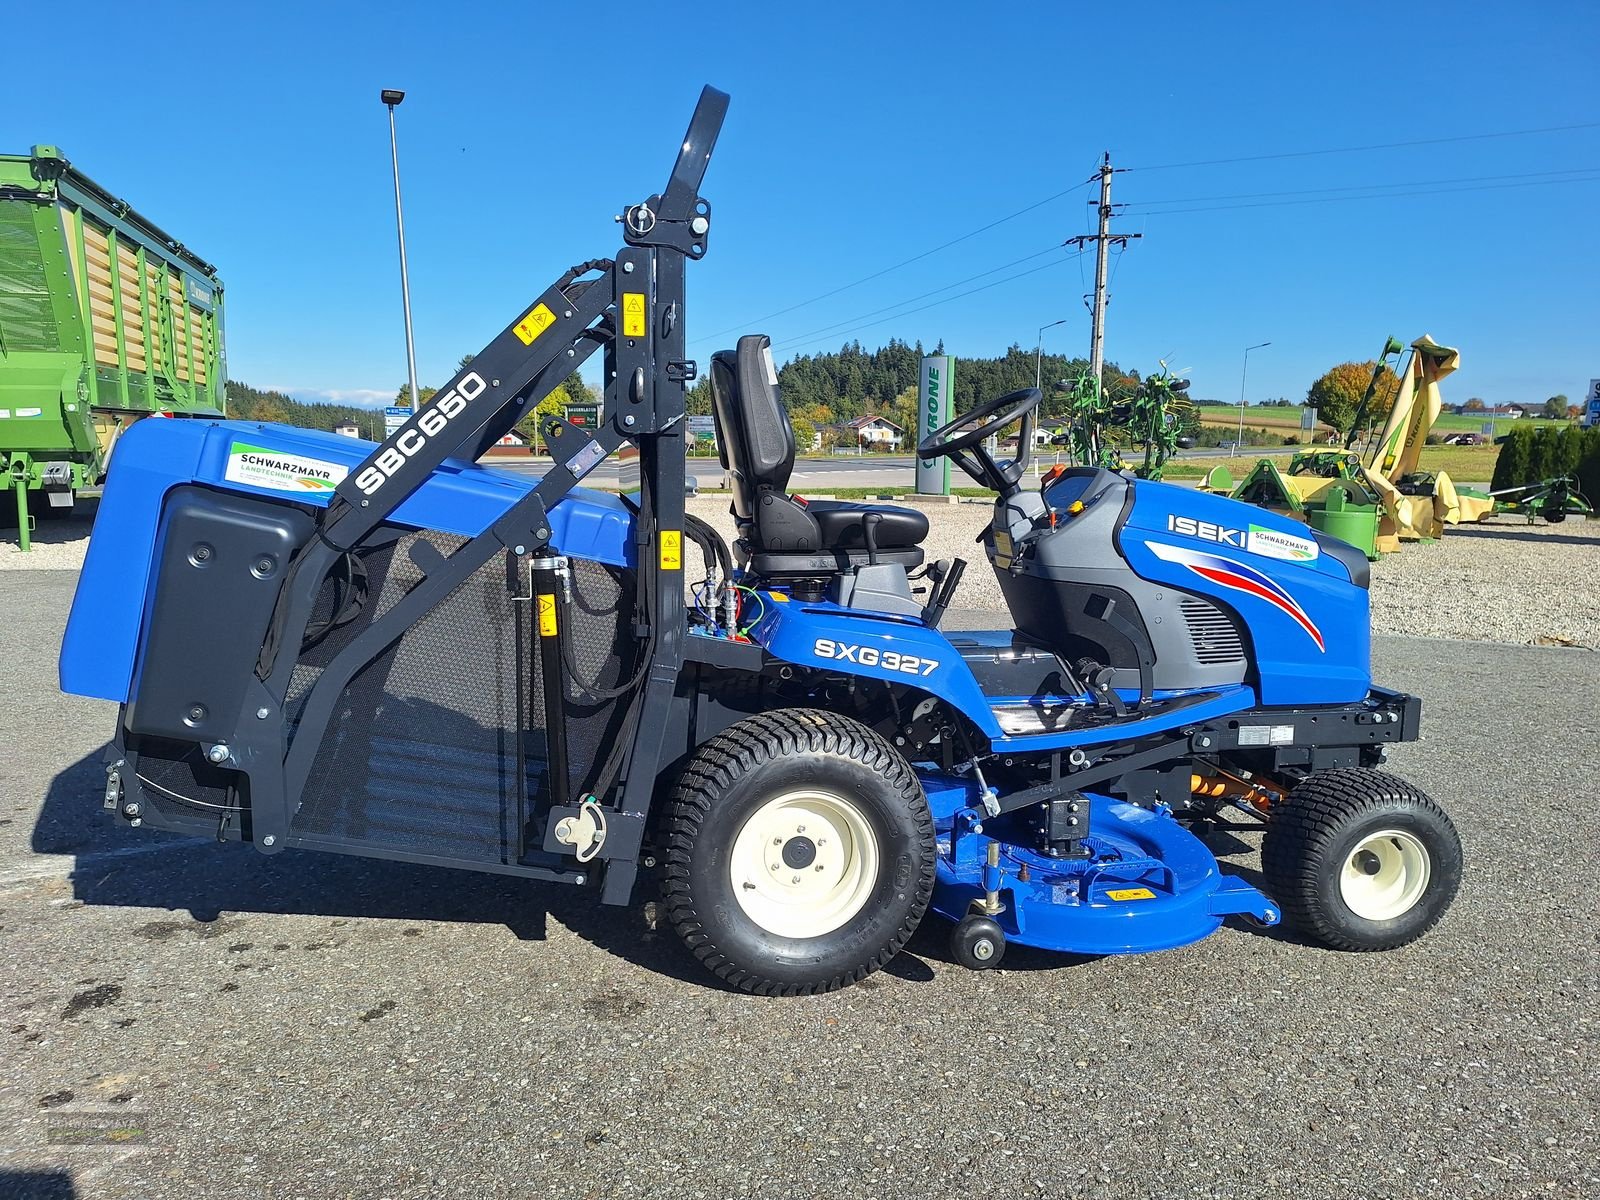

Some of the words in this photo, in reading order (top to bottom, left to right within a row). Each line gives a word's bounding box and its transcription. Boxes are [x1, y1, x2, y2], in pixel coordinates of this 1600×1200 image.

[354, 371, 487, 496] SBC650
[240, 464, 293, 481] LANDTECHNIK
[241, 454, 331, 480] SCHWARZMAYR
[1167, 513, 1247, 549] ISEKI
[1255, 532, 1309, 552] SCHWARZMAYR
